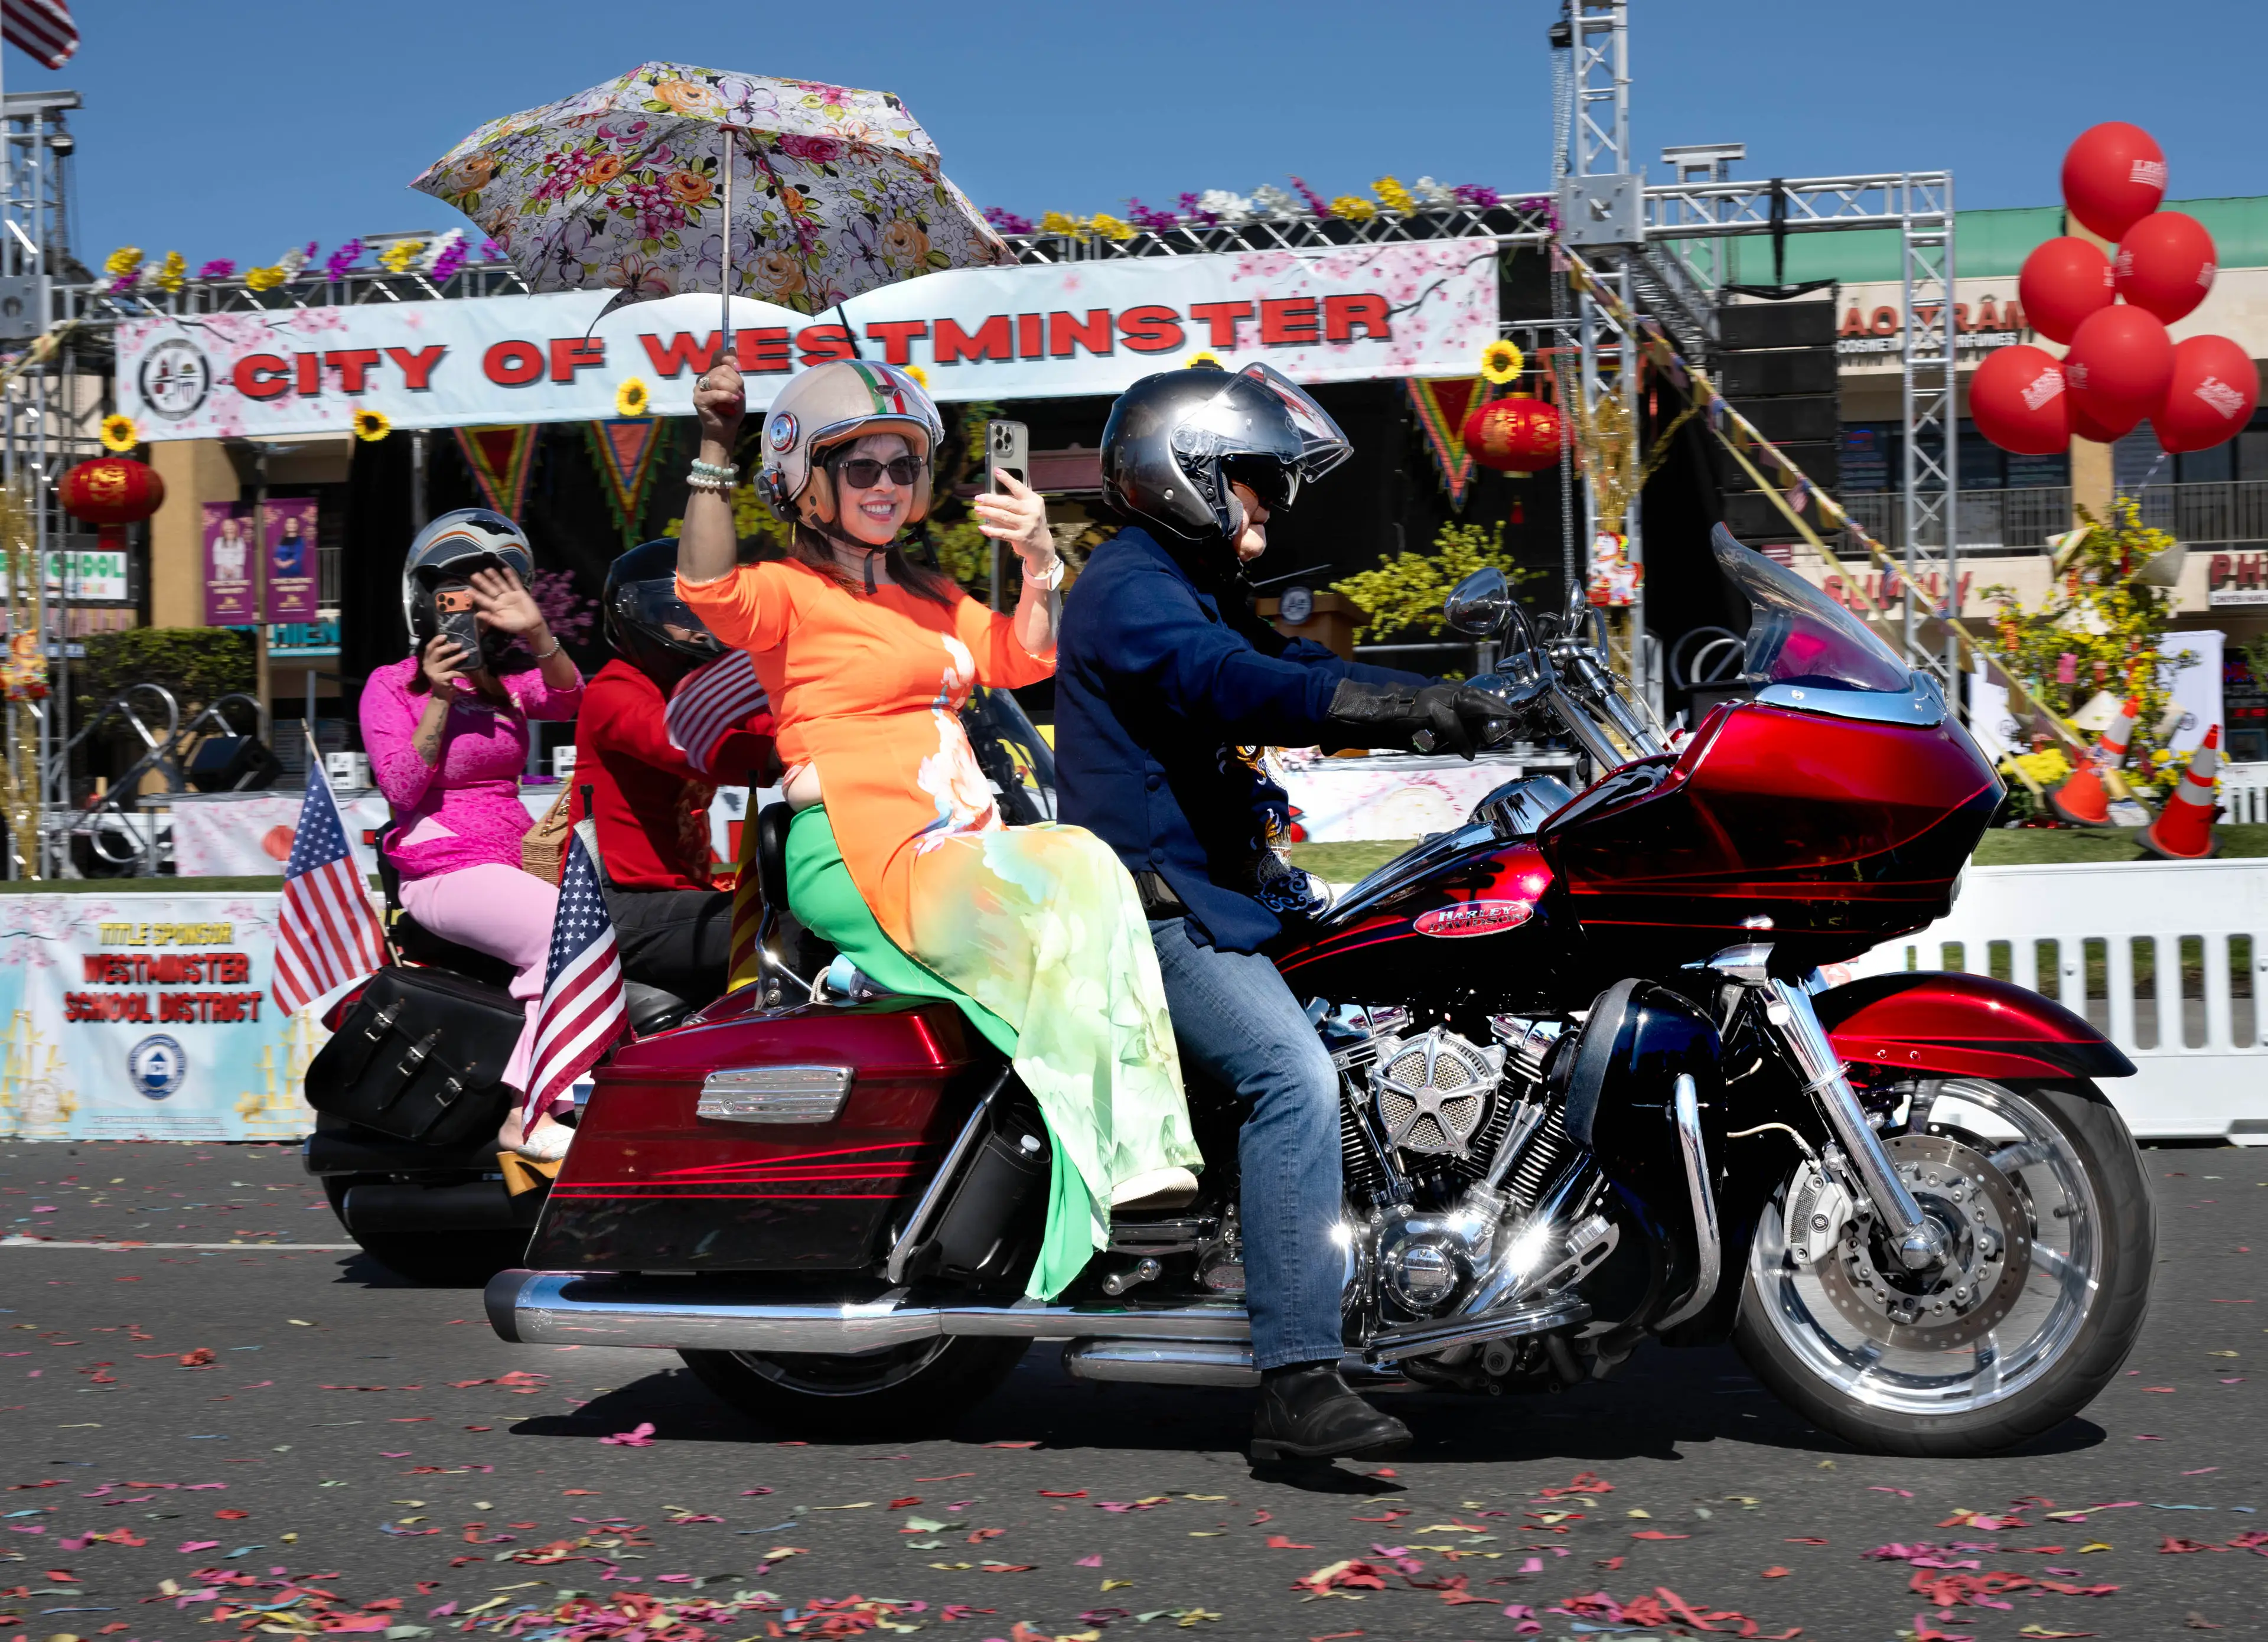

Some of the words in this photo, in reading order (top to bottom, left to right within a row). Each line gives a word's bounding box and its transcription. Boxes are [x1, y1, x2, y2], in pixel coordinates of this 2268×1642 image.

[233, 344, 450, 401] CITY
[483, 336, 608, 389] OF
[638, 292, 1392, 380] WESTMINSTER
[2210, 553, 2268, 585] PH
[98, 922, 147, 946] TITLE
[151, 921, 233, 946] SPONSOR
[1427, 913, 1526, 934] DAVIDSON
[82, 952, 250, 985] WESTMINSTER
[63, 991, 153, 1024] SCHOOL
[157, 991, 263, 1023] DISTRICT
